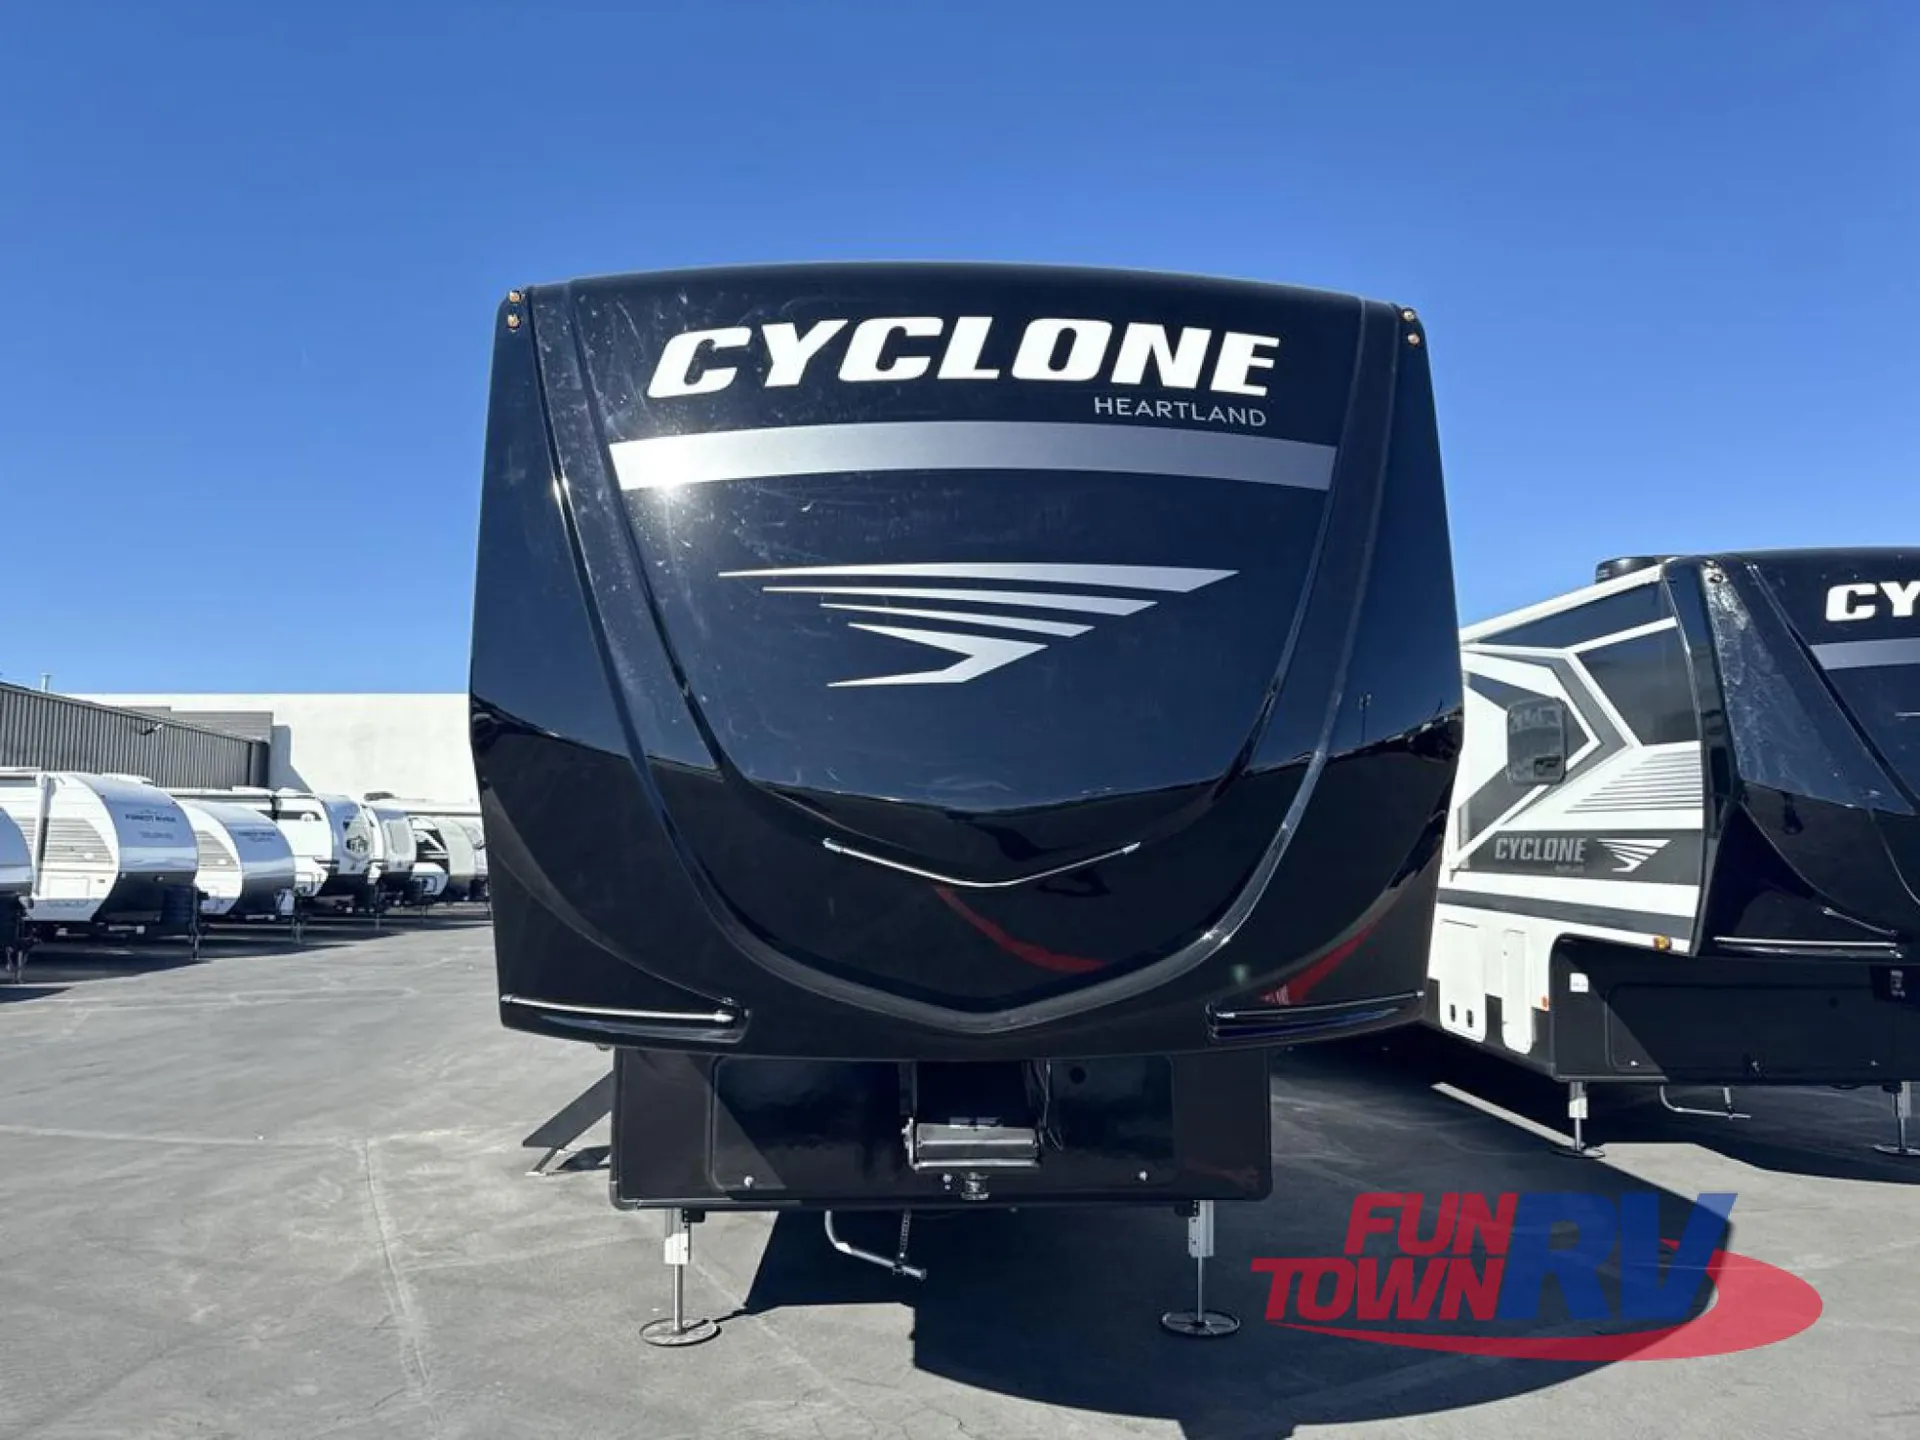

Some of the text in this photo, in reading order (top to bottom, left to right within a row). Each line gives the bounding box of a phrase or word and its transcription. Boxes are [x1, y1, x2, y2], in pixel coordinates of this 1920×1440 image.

[648, 316, 1280, 400] CYCLONE
[1093, 396, 1267, 427] HEARTLAND
[1495, 837, 1587, 862] CYCLONE
